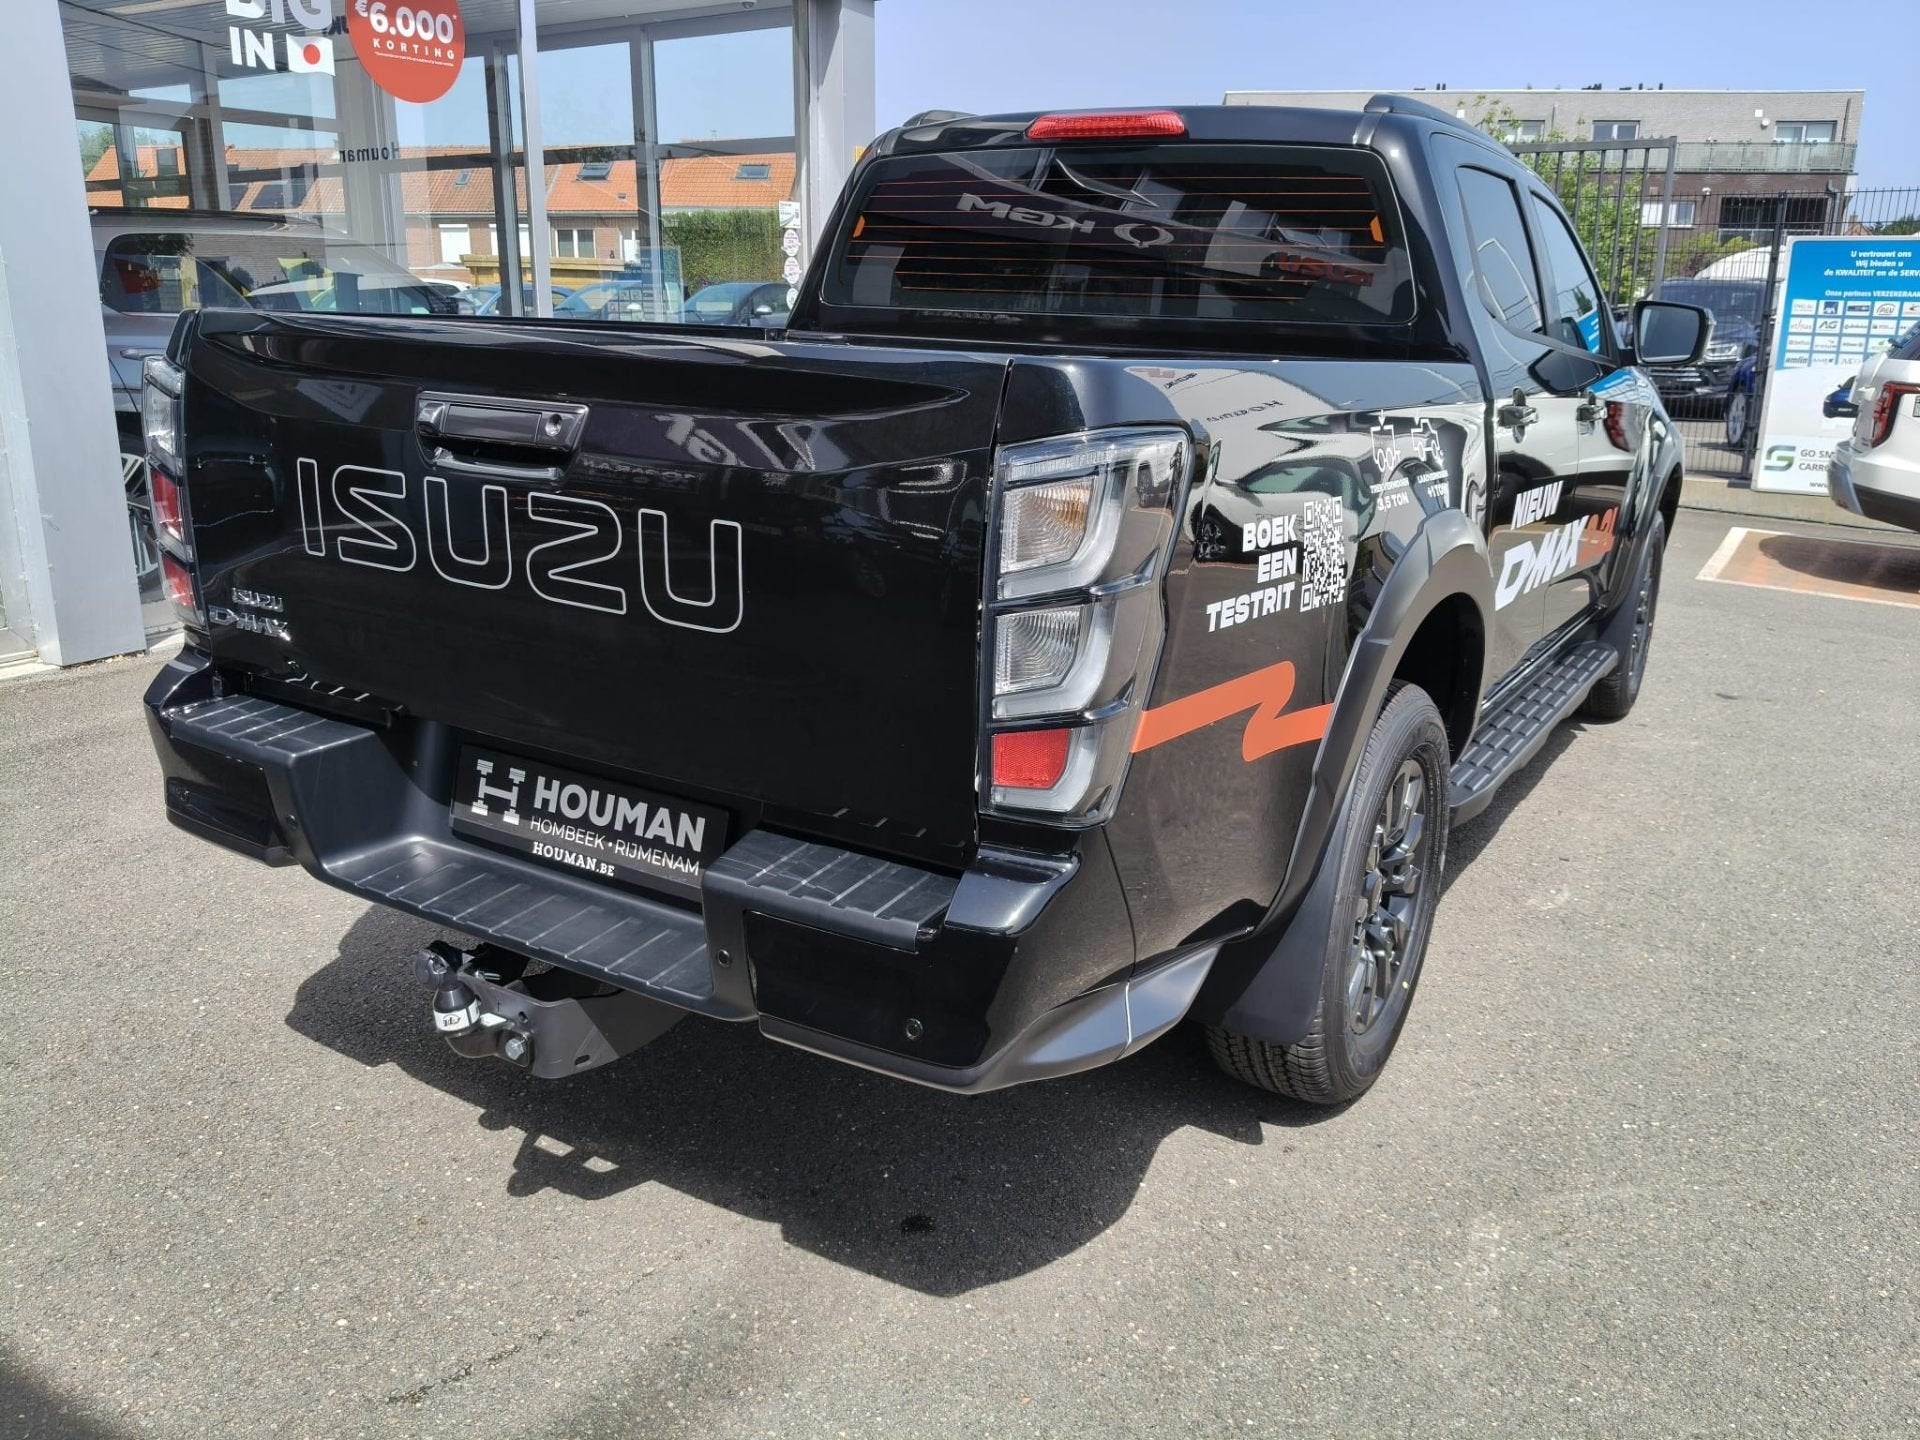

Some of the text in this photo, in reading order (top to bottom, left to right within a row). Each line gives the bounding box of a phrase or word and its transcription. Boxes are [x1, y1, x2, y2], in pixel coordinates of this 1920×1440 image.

[229, 26, 276, 71] IN
[372, 37, 455, 60] KORTING
[1824, 268, 1834, 276] de
[1888, 268, 1898, 276] de
[1856, 259, 1868, 268] Wij
[1858, 250, 1896, 258] vertrouwt
[1800, 448, 1816, 458] GO
[1377, 491, 1410, 512] 3,5 TON
[1510, 480, 1564, 531] NIEUW
[296, 457, 744, 634] ISUZU
[1242, 513, 1298, 552] BOEK
[1257, 547, 1297, 584] EEN
[232, 587, 284, 613] ISUZU
[1206, 581, 1296, 633] TESTRIT
[533, 775, 706, 852] HOUMAN
[530, 815, 701, 877] HOMBEEK RIJMENAM
[532, 841, 616, 878] HOUMAN.BE
